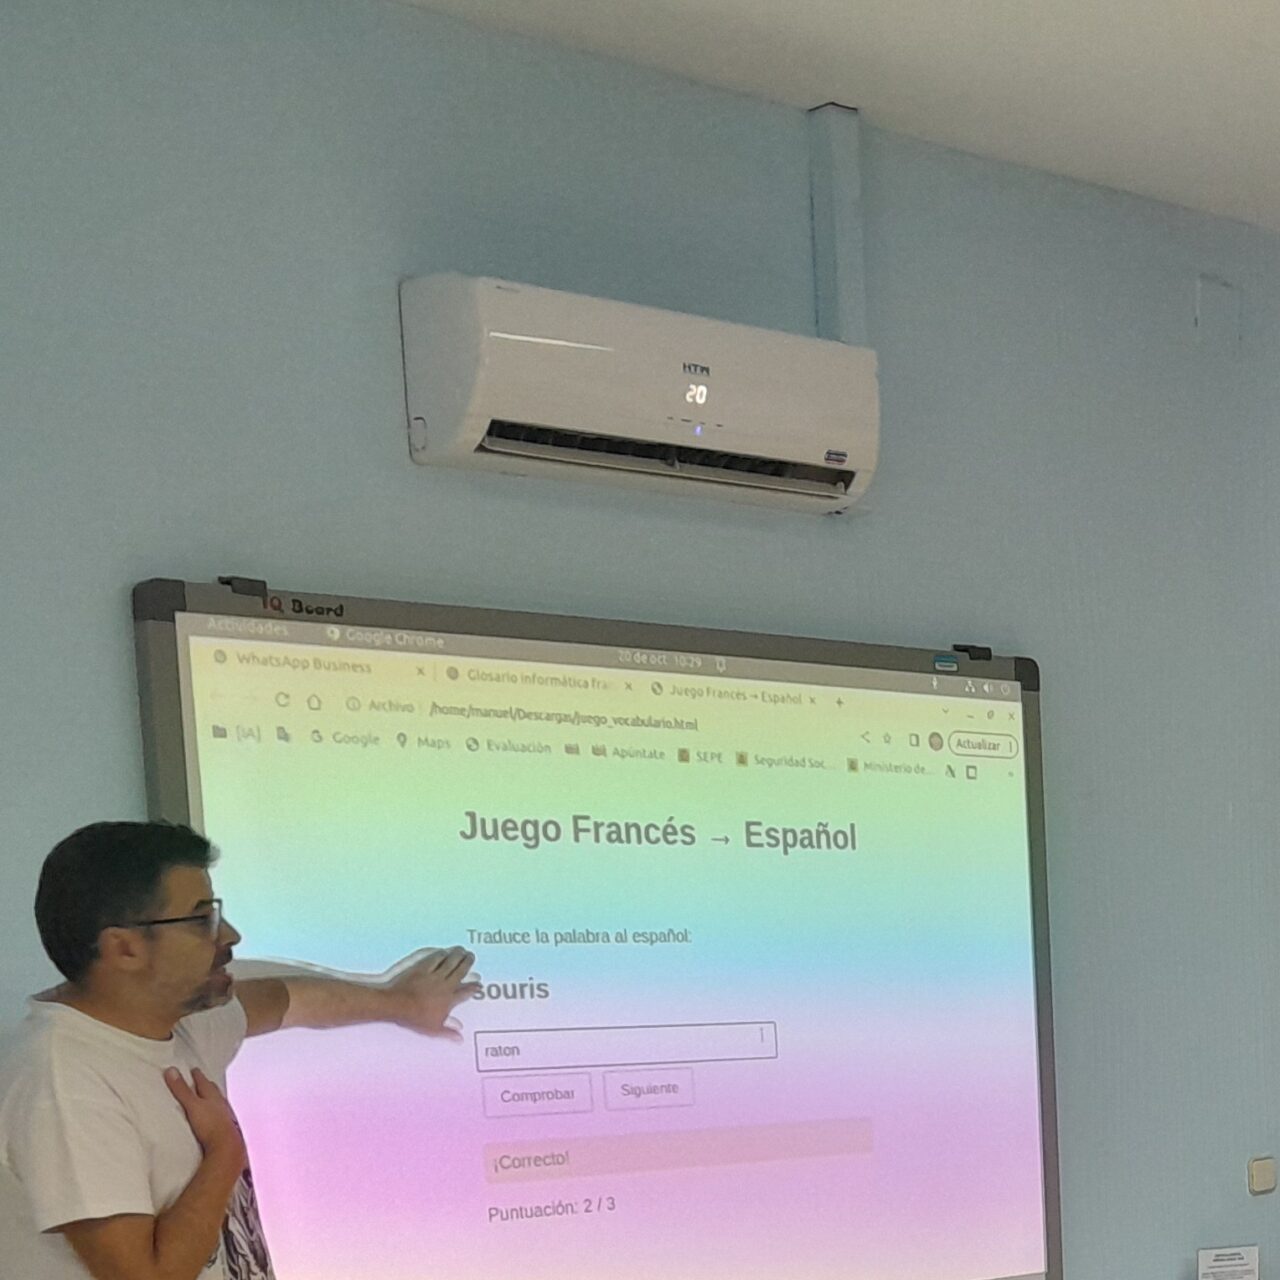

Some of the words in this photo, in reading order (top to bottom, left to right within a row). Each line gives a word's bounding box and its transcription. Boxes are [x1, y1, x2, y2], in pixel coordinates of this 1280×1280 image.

[685, 383, 708, 404] 20
[291, 598, 344, 617] Board
[207, 617, 290, 637] Actividades
[346, 629, 392, 645] Google
[395, 632, 445, 649] Chrome
[235, 651, 310, 671] WhatsApp
[313, 657, 373, 674] Business
[633, 651, 648, 664] de
[467, 669, 518, 685] Glosario
[520, 672, 589, 690] informática
[670, 684, 704, 700] Juego
[706, 686, 748, 701] Francés
[761, 690, 803, 706] Español
[368, 700, 415, 714] Archivo
[332, 731, 380, 749] Google
[417, 736, 451, 751] Maps
[486, 738, 552, 754] Evaluación
[955, 737, 1002, 752] Actualizar
[696, 750, 723, 764] SEPE
[753, 753, 806, 769] Seguridad
[863, 760, 912, 774] Ministerio
[458, 810, 562, 849] Juego
[571, 814, 697, 846] Francés
[744, 819, 858, 856] Español
[466, 928, 531, 945] Traduce
[534, 928, 550, 944] la
[553, 928, 611, 947] palabra
[614, 928, 629, 944] al
[631, 928, 693, 947] español:
[472, 976, 550, 1001] souris
[484, 1042, 521, 1058] raton
[500, 1086, 576, 1106] Comprobar
[619, 1081, 680, 1099] Siguiente
[492, 1150, 571, 1174] ¡Correcto!
[487, 1199, 579, 1222] Puntuación:
[583, 1199, 594, 1214] 2
[606, 1196, 617, 1211] 3
